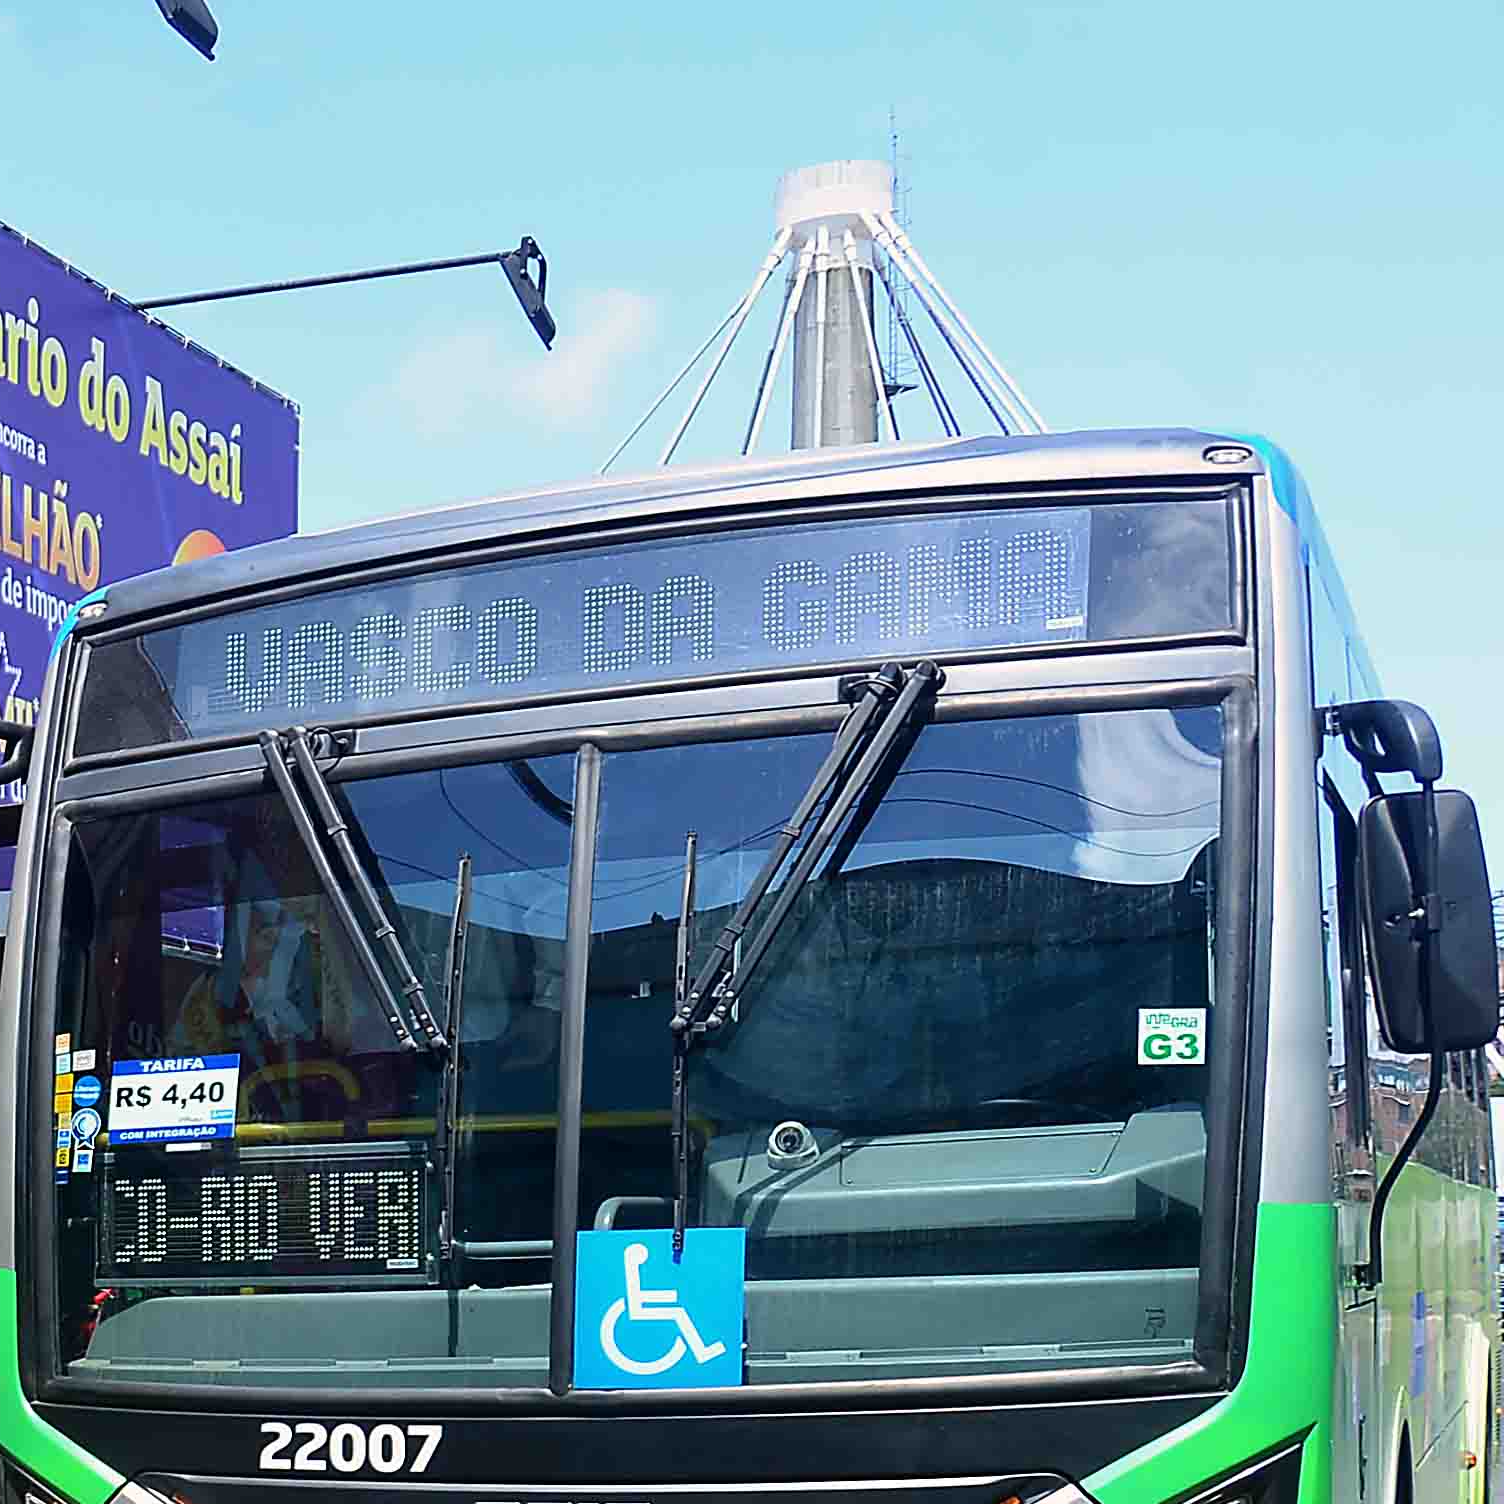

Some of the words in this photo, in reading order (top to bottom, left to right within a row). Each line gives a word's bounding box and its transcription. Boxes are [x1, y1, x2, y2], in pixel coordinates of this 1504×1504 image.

[79, 338, 131, 443] do
[139, 376, 243, 505] Assaí
[37, 443, 47, 465] a
[0, 567, 23, 608] de
[25, 575, 78, 631] impo
[225, 597, 538, 713] VASCO
[583, 574, 715, 674] DA
[762, 529, 1068, 652] GAMA
[1143, 1033, 1199, 1060] G3
[140, 1057, 205, 1073] TARIFA
[115, 1085, 152, 1109] R$
[161, 1081, 225, 1109] 4,40
[119, 1131, 145, 1141] COM
[145, 1126, 217, 1140] INTEGRAÇÃO
[257, 1422, 444, 1474] 22007
